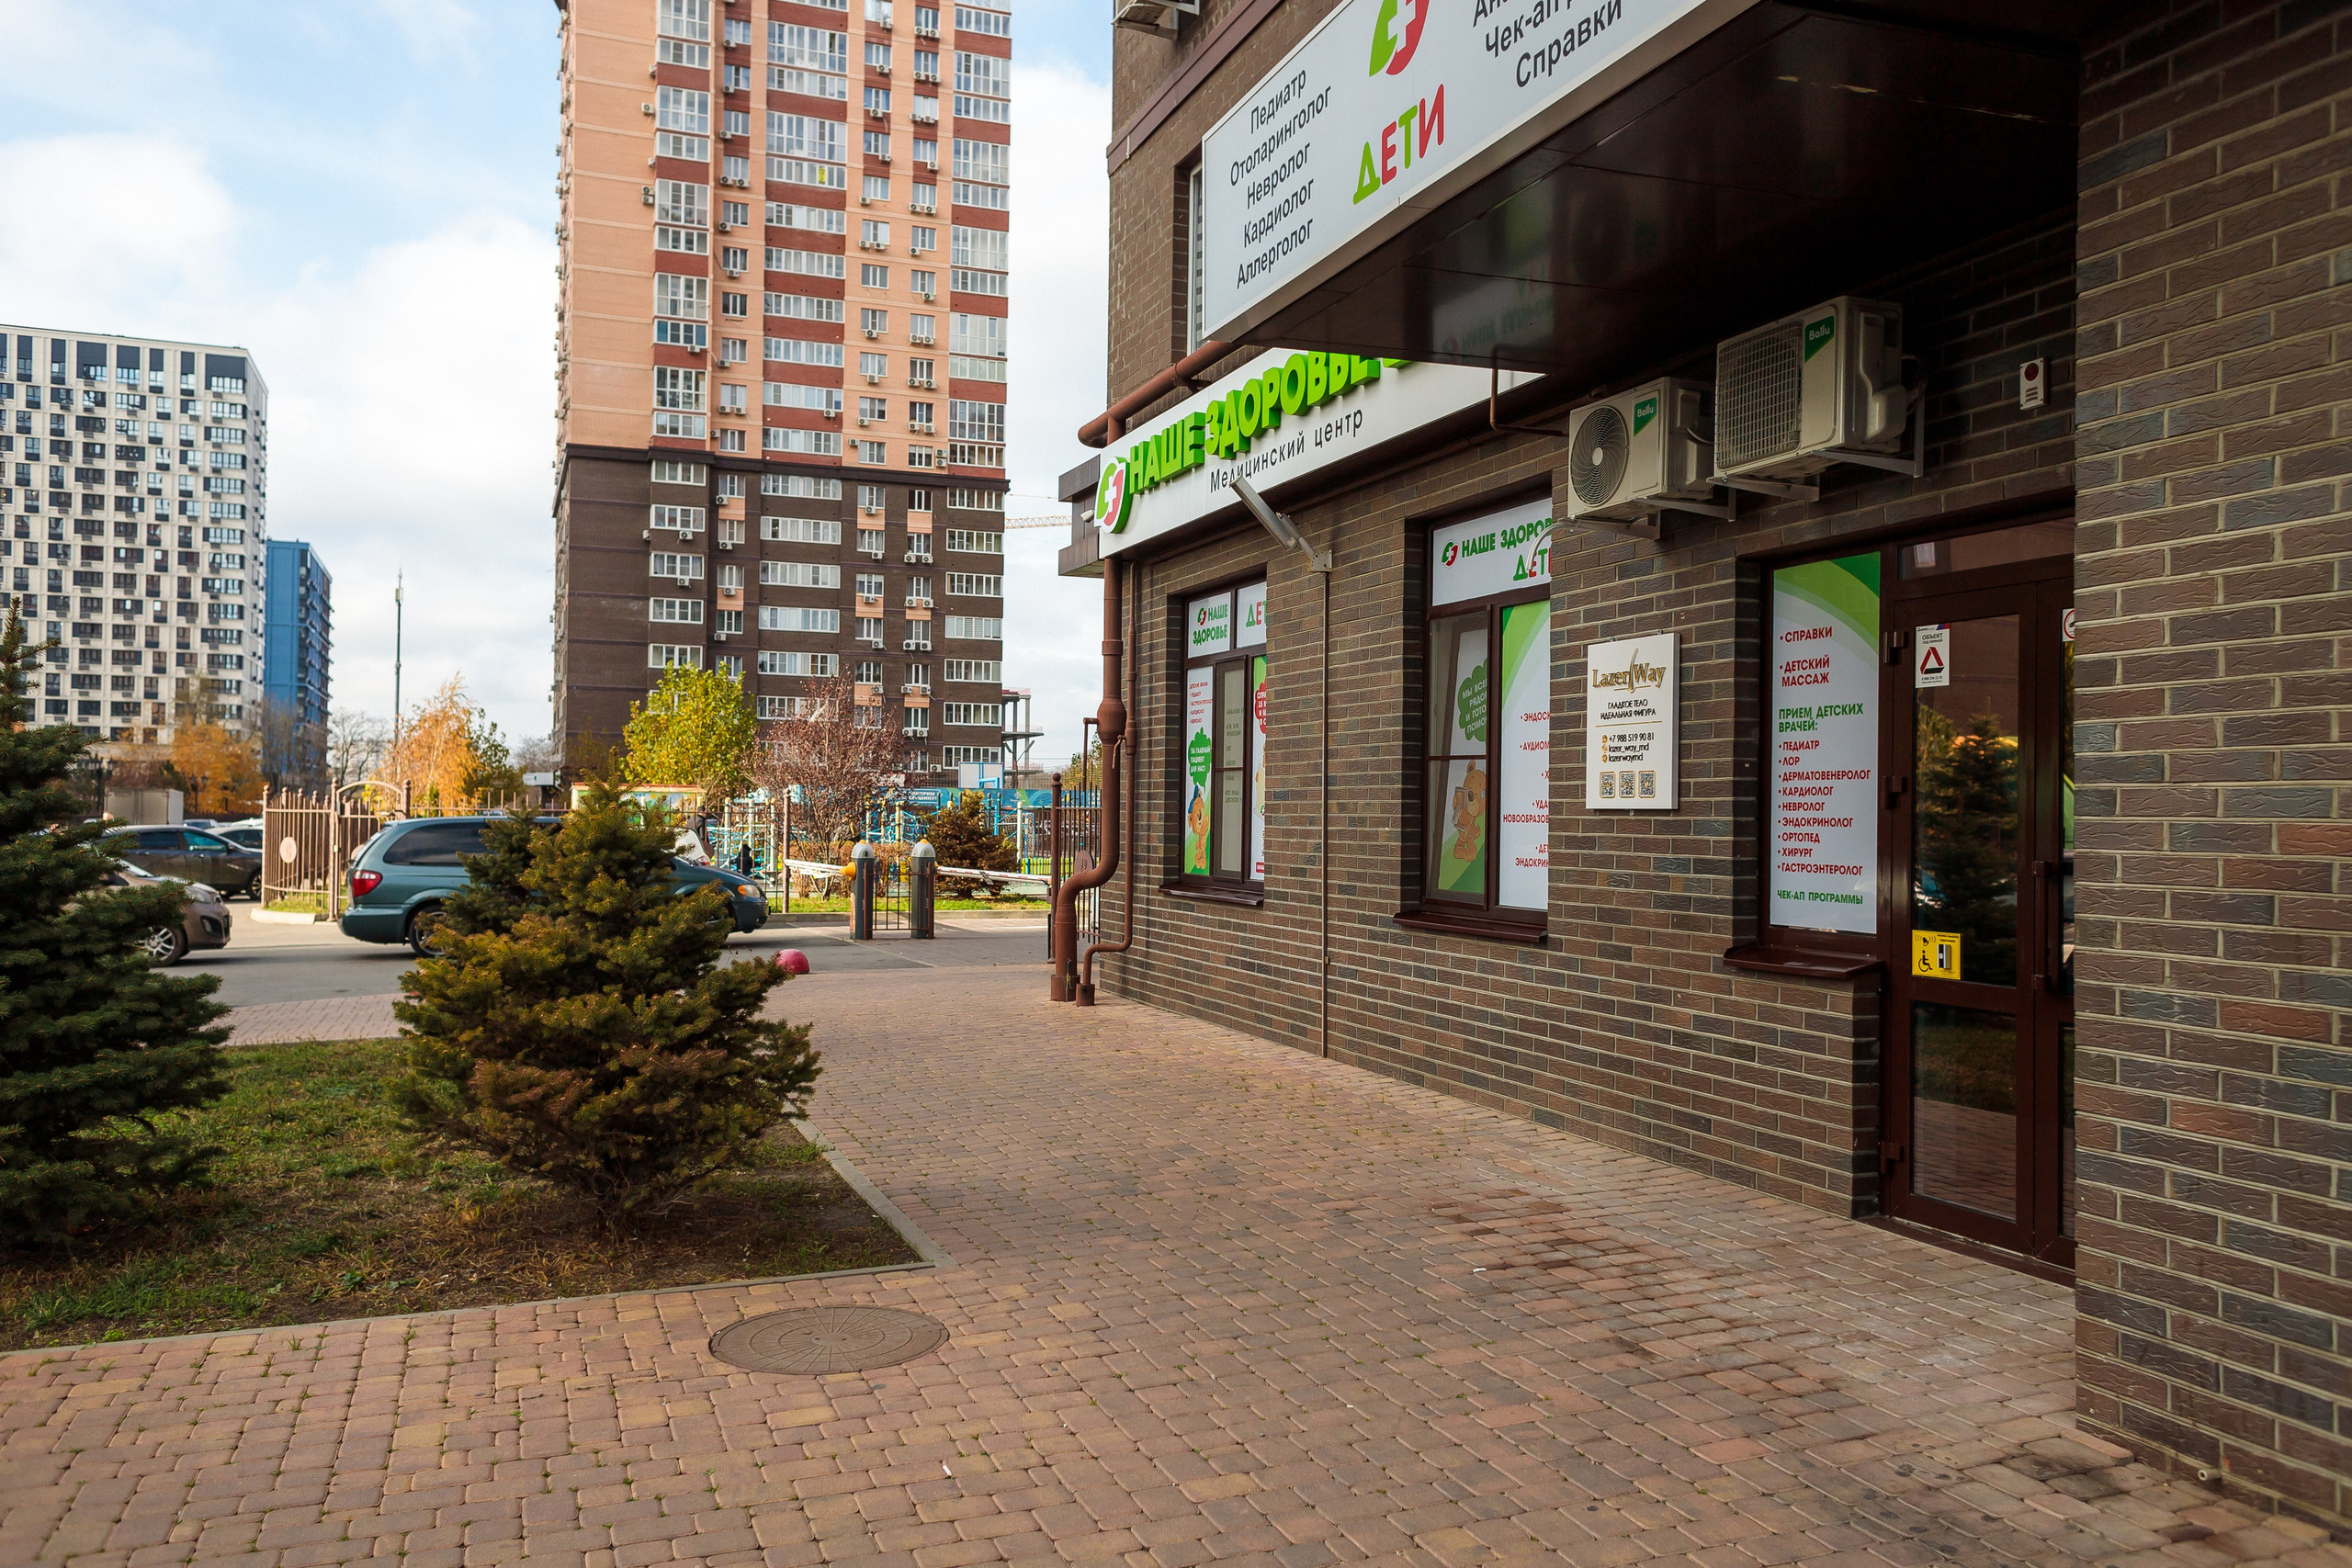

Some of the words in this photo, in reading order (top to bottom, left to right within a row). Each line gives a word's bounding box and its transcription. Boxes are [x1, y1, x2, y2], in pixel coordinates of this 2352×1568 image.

[1516, 0, 1622, 88] Справки
[1250, 70, 1306, 134] Педиатр
[1230, 85, 1331, 186] Отоларинголог
[1353, 84, 1445, 206] ДЕТИ
[1248, 142, 1310, 210] Невролог
[1244, 178, 1314, 248] Кардиолог
[1237, 218, 1313, 289] Аллерголог
[1809, 323, 1830, 341] Ballu
[1637, 404, 1654, 418] Ballu
[1315, 409, 1363, 449] центр
[1130, 412, 1204, 495] НАШЕ
[1462, 533, 1496, 558] НАШЕ
[1512, 547, 1553, 581] ДЕТ
[1208, 604, 1228, 622] НАШЕ
[1193, 624, 1227, 646] ЗДОРОВЬЕ
[1785, 626, 1833, 643] СПРАВКИ
[1921, 632, 1943, 640] ОБЪЕКТ
[1784, 654, 1830, 674] ДЕТСКИЙ
[1592, 669, 1630, 688] Lazer
[1633, 662, 1667, 689] Way
[1781, 672, 1829, 687] МАССАЖ
[1462, 686, 1473, 700] МЫ
[1608, 700, 1633, 709] ГЛАДКОЕ
[1634, 698, 1648, 707] ТЕЛО
[1779, 706, 1813, 719] ПРИЕМ
[1815, 703, 1864, 719] ДЕТСКИХ
[1600, 709, 1633, 720] ИДЕАЛЬНАЯ
[1633, 708, 1657, 716] ФИГУРА
[1466, 716, 1487, 734] ПОМО
[1778, 716, 1818, 733] ВРАЧЕЙ:
[1609, 734, 1616, 743] +7
[1616, 734, 1627, 742] 988
[1627, 733, 1639, 742] 519
[1639, 732, 1646, 741] 90
[1646, 732, 1655, 741] 81
[1782, 739, 1820, 751] ПЕДИАТР
[1782, 756, 1800, 766] ЛОР
[1782, 770, 1871, 783] ДЕРМАТОВЕНЕРОЛОГ
[1782, 786, 1834, 797] КАРДИОЛОГ
[1782, 801, 1826, 812] НЕВРОЛОГ
[1781, 817, 1853, 829] ЭНДОКРИНОЛОГ
[1781, 832, 1820, 844] ОРТОПЕД
[1781, 847, 1813, 857] ХИРУРГ
[1781, 863, 1863, 875] ГАСТРОЭНТЕРОЛОГ
[1777, 889, 1805, 901] ЧЕК-АП
[1808, 891, 1863, 905] ПРОГРАММЫ
